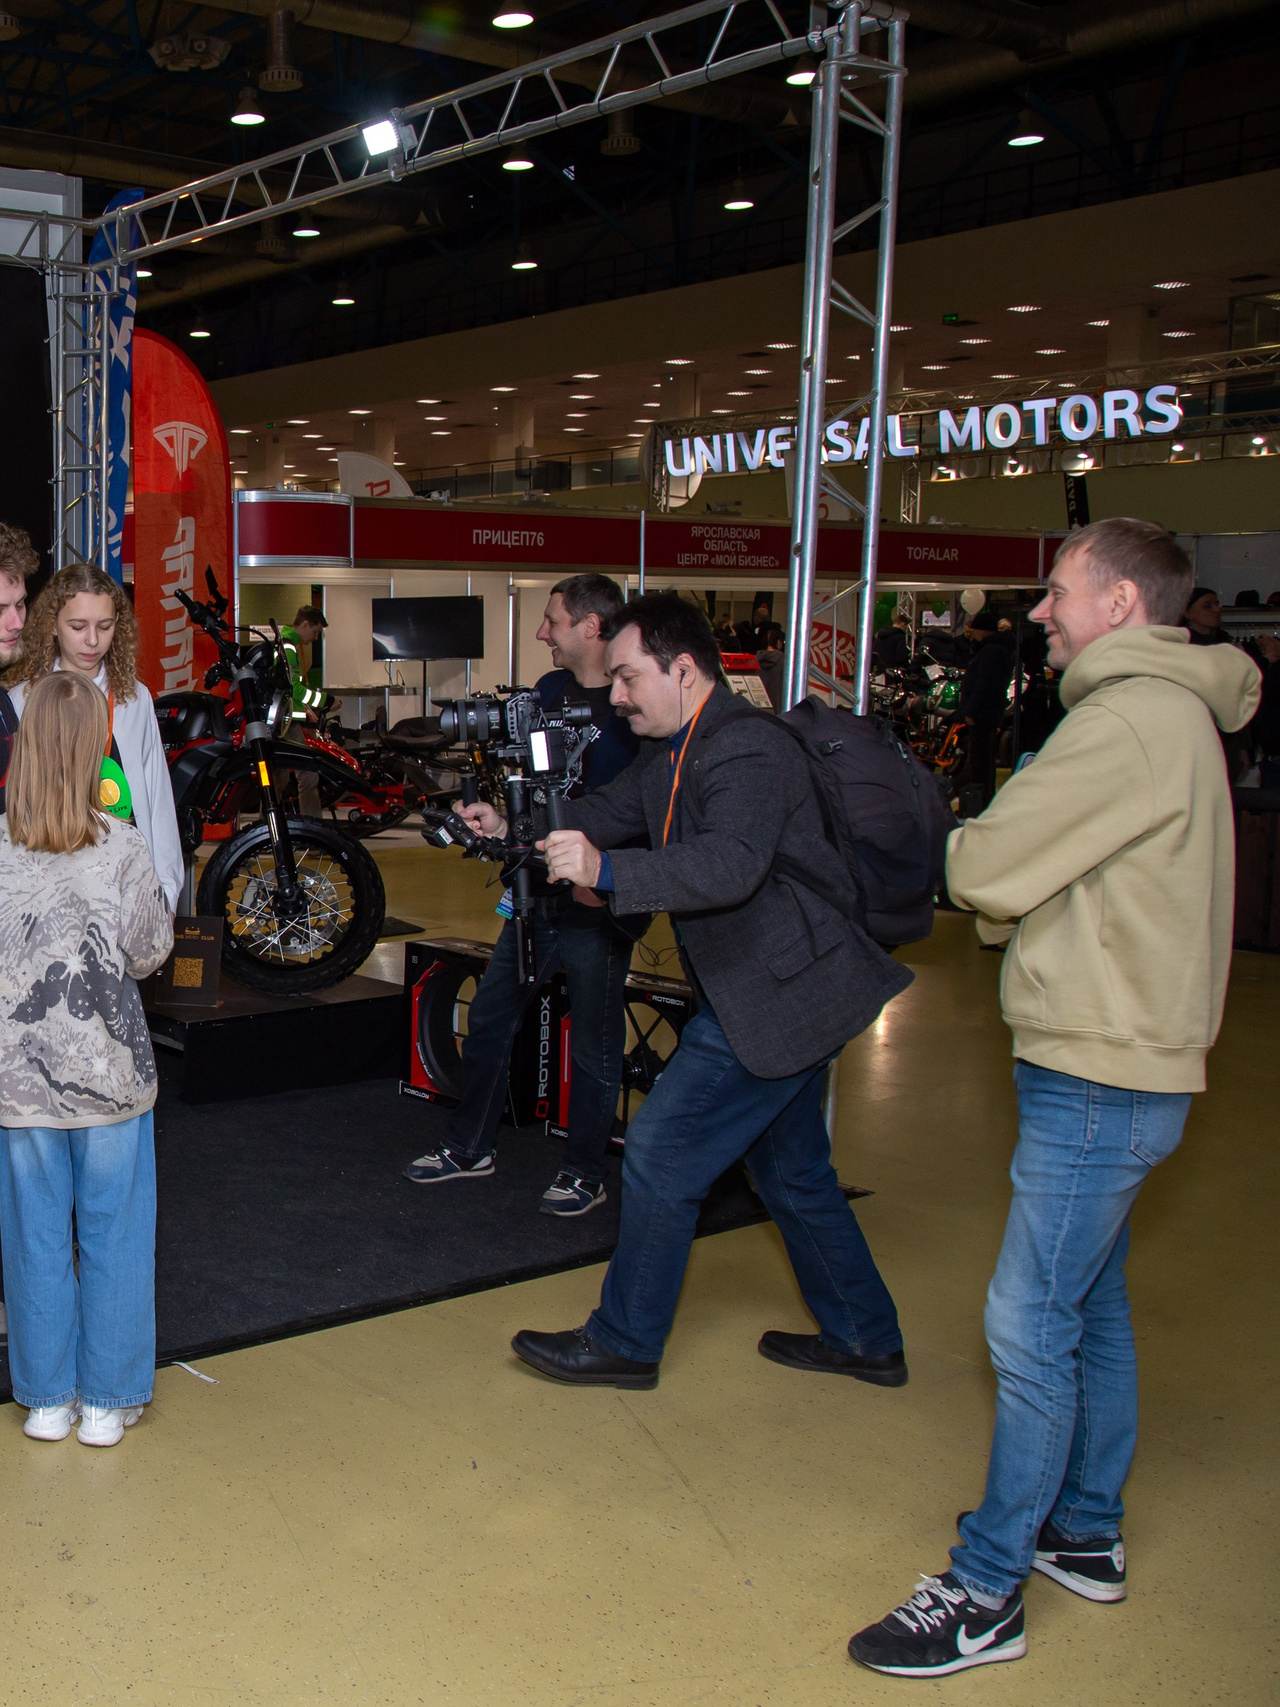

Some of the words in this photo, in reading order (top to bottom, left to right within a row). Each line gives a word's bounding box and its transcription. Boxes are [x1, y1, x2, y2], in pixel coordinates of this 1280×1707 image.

[664, 414, 919, 477] UNIVESAL
[938, 385, 1184, 454] MOTORS
[472, 529, 545, 548] ПРИЦЕП76
[691, 526, 761, 540] ЯРОСЛАВСКАЯ
[704, 540, 748, 552] ОБЛАСТЬ
[677, 553, 709, 566] ЦЕНТР
[907, 546, 959, 561] TOFALAR
[652, 994, 685, 1007] ROTOBOX
[537, 995, 551, 1098] ROTOBOX
